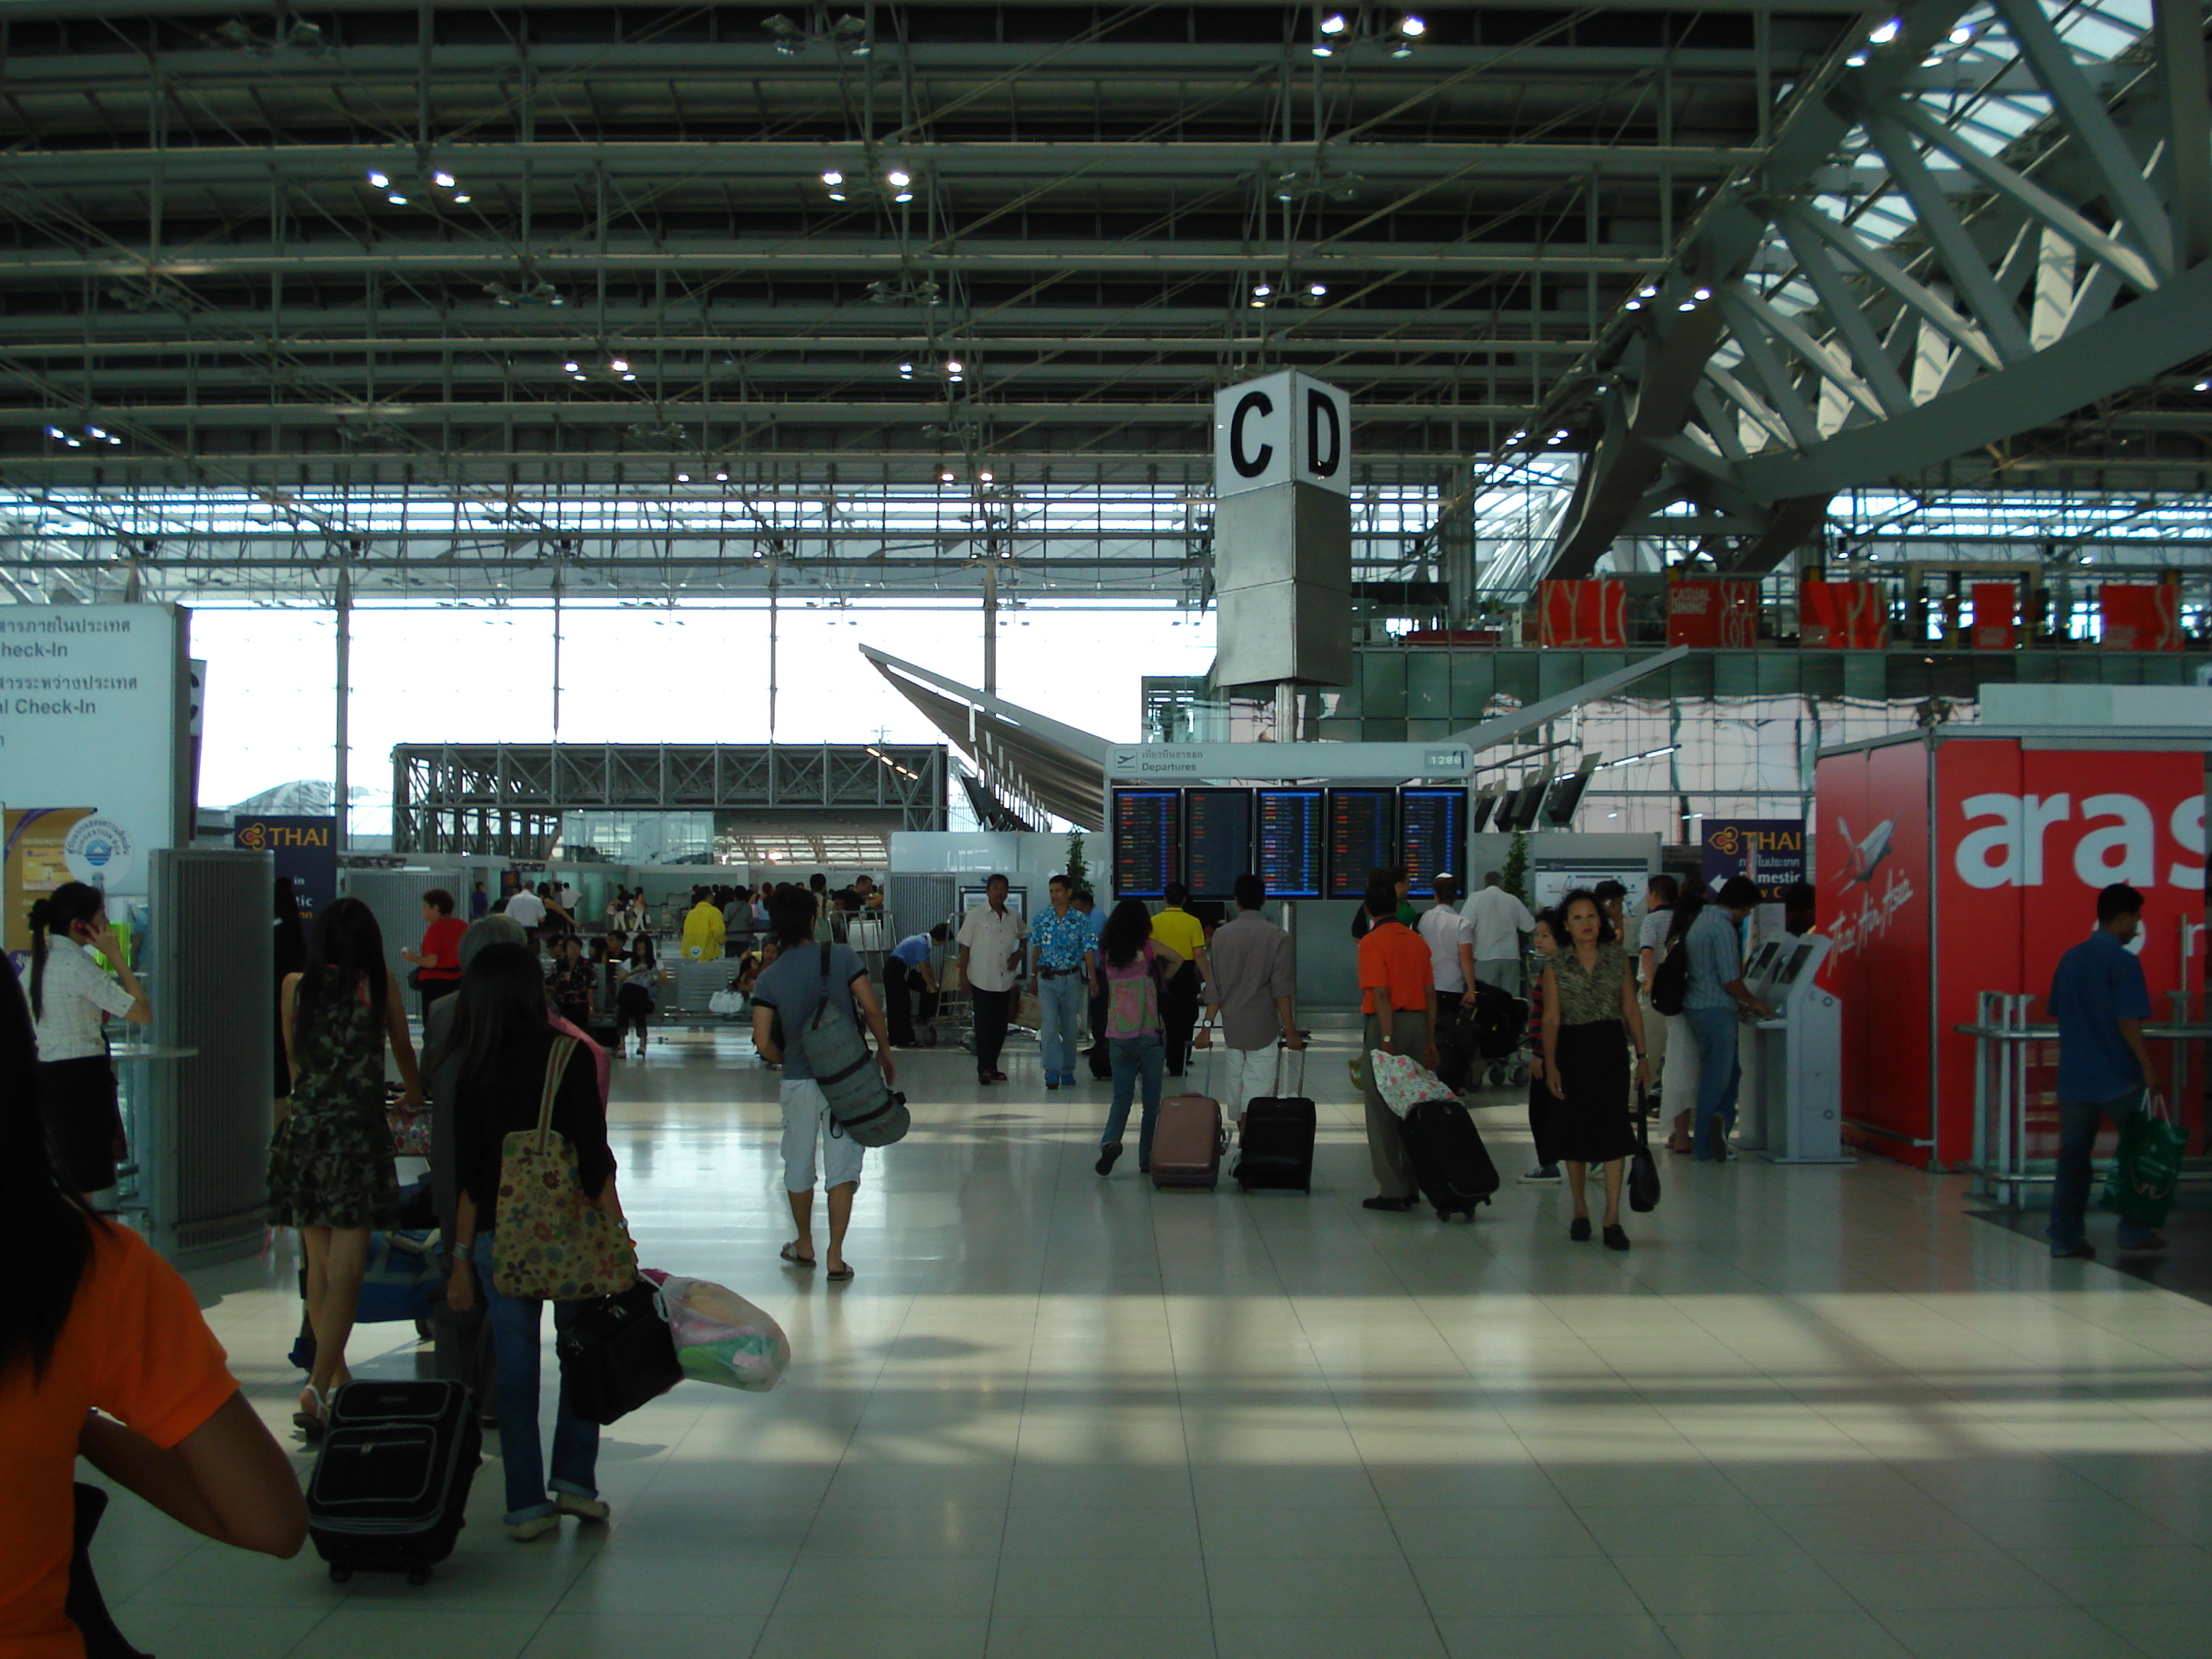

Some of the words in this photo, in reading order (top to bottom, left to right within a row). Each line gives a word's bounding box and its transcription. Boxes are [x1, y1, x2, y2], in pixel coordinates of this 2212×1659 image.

[1231, 391, 1274, 478] C
[1308, 387, 1340, 477] D
[1671, 587, 1712, 602] CASUAL
[1671, 601, 1707, 615] DINING
[15, 698, 96, 714] Check-In
[1142, 763, 1197, 773] Departures
[268, 827, 328, 847] THAI
[1741, 831, 1802, 851] THAI
[1739, 871, 1802, 884] mestic
